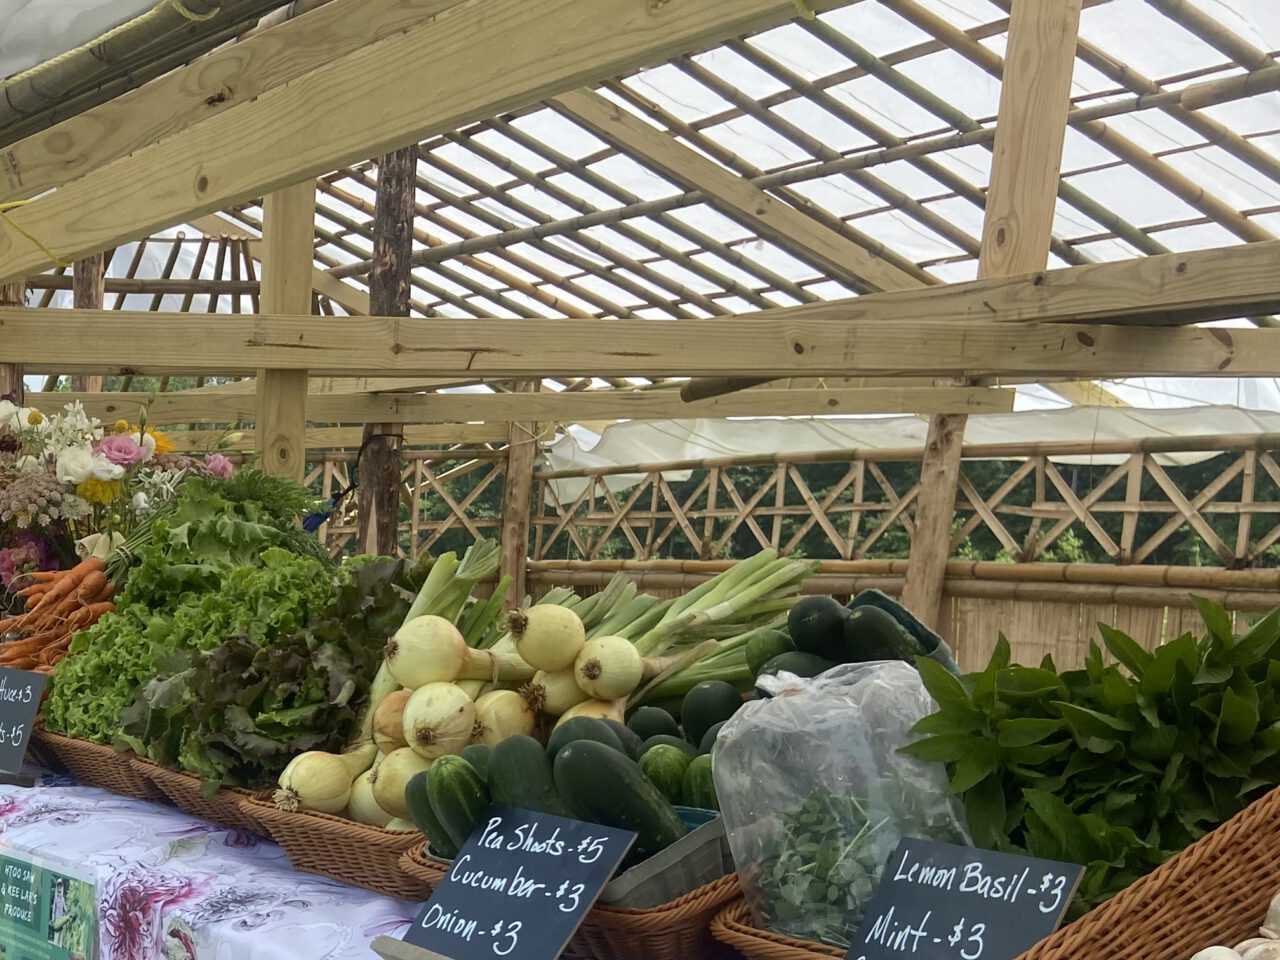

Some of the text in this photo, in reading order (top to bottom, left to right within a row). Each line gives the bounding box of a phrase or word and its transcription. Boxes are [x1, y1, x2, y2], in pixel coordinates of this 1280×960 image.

[477, 816, 503, 849] Pea
[506, 822, 565, 856] Shoots
[4, 863, 22, 880] HTOO
[7, 884, 20, 898] KEE
[893, 850, 957, 890] Lemon
[959, 862, 1030, 903] Basil
[3, 903, 32, 922] PRODUCE
[421, 903, 478, 942] Onion
[864, 905, 932, 953] Mint
